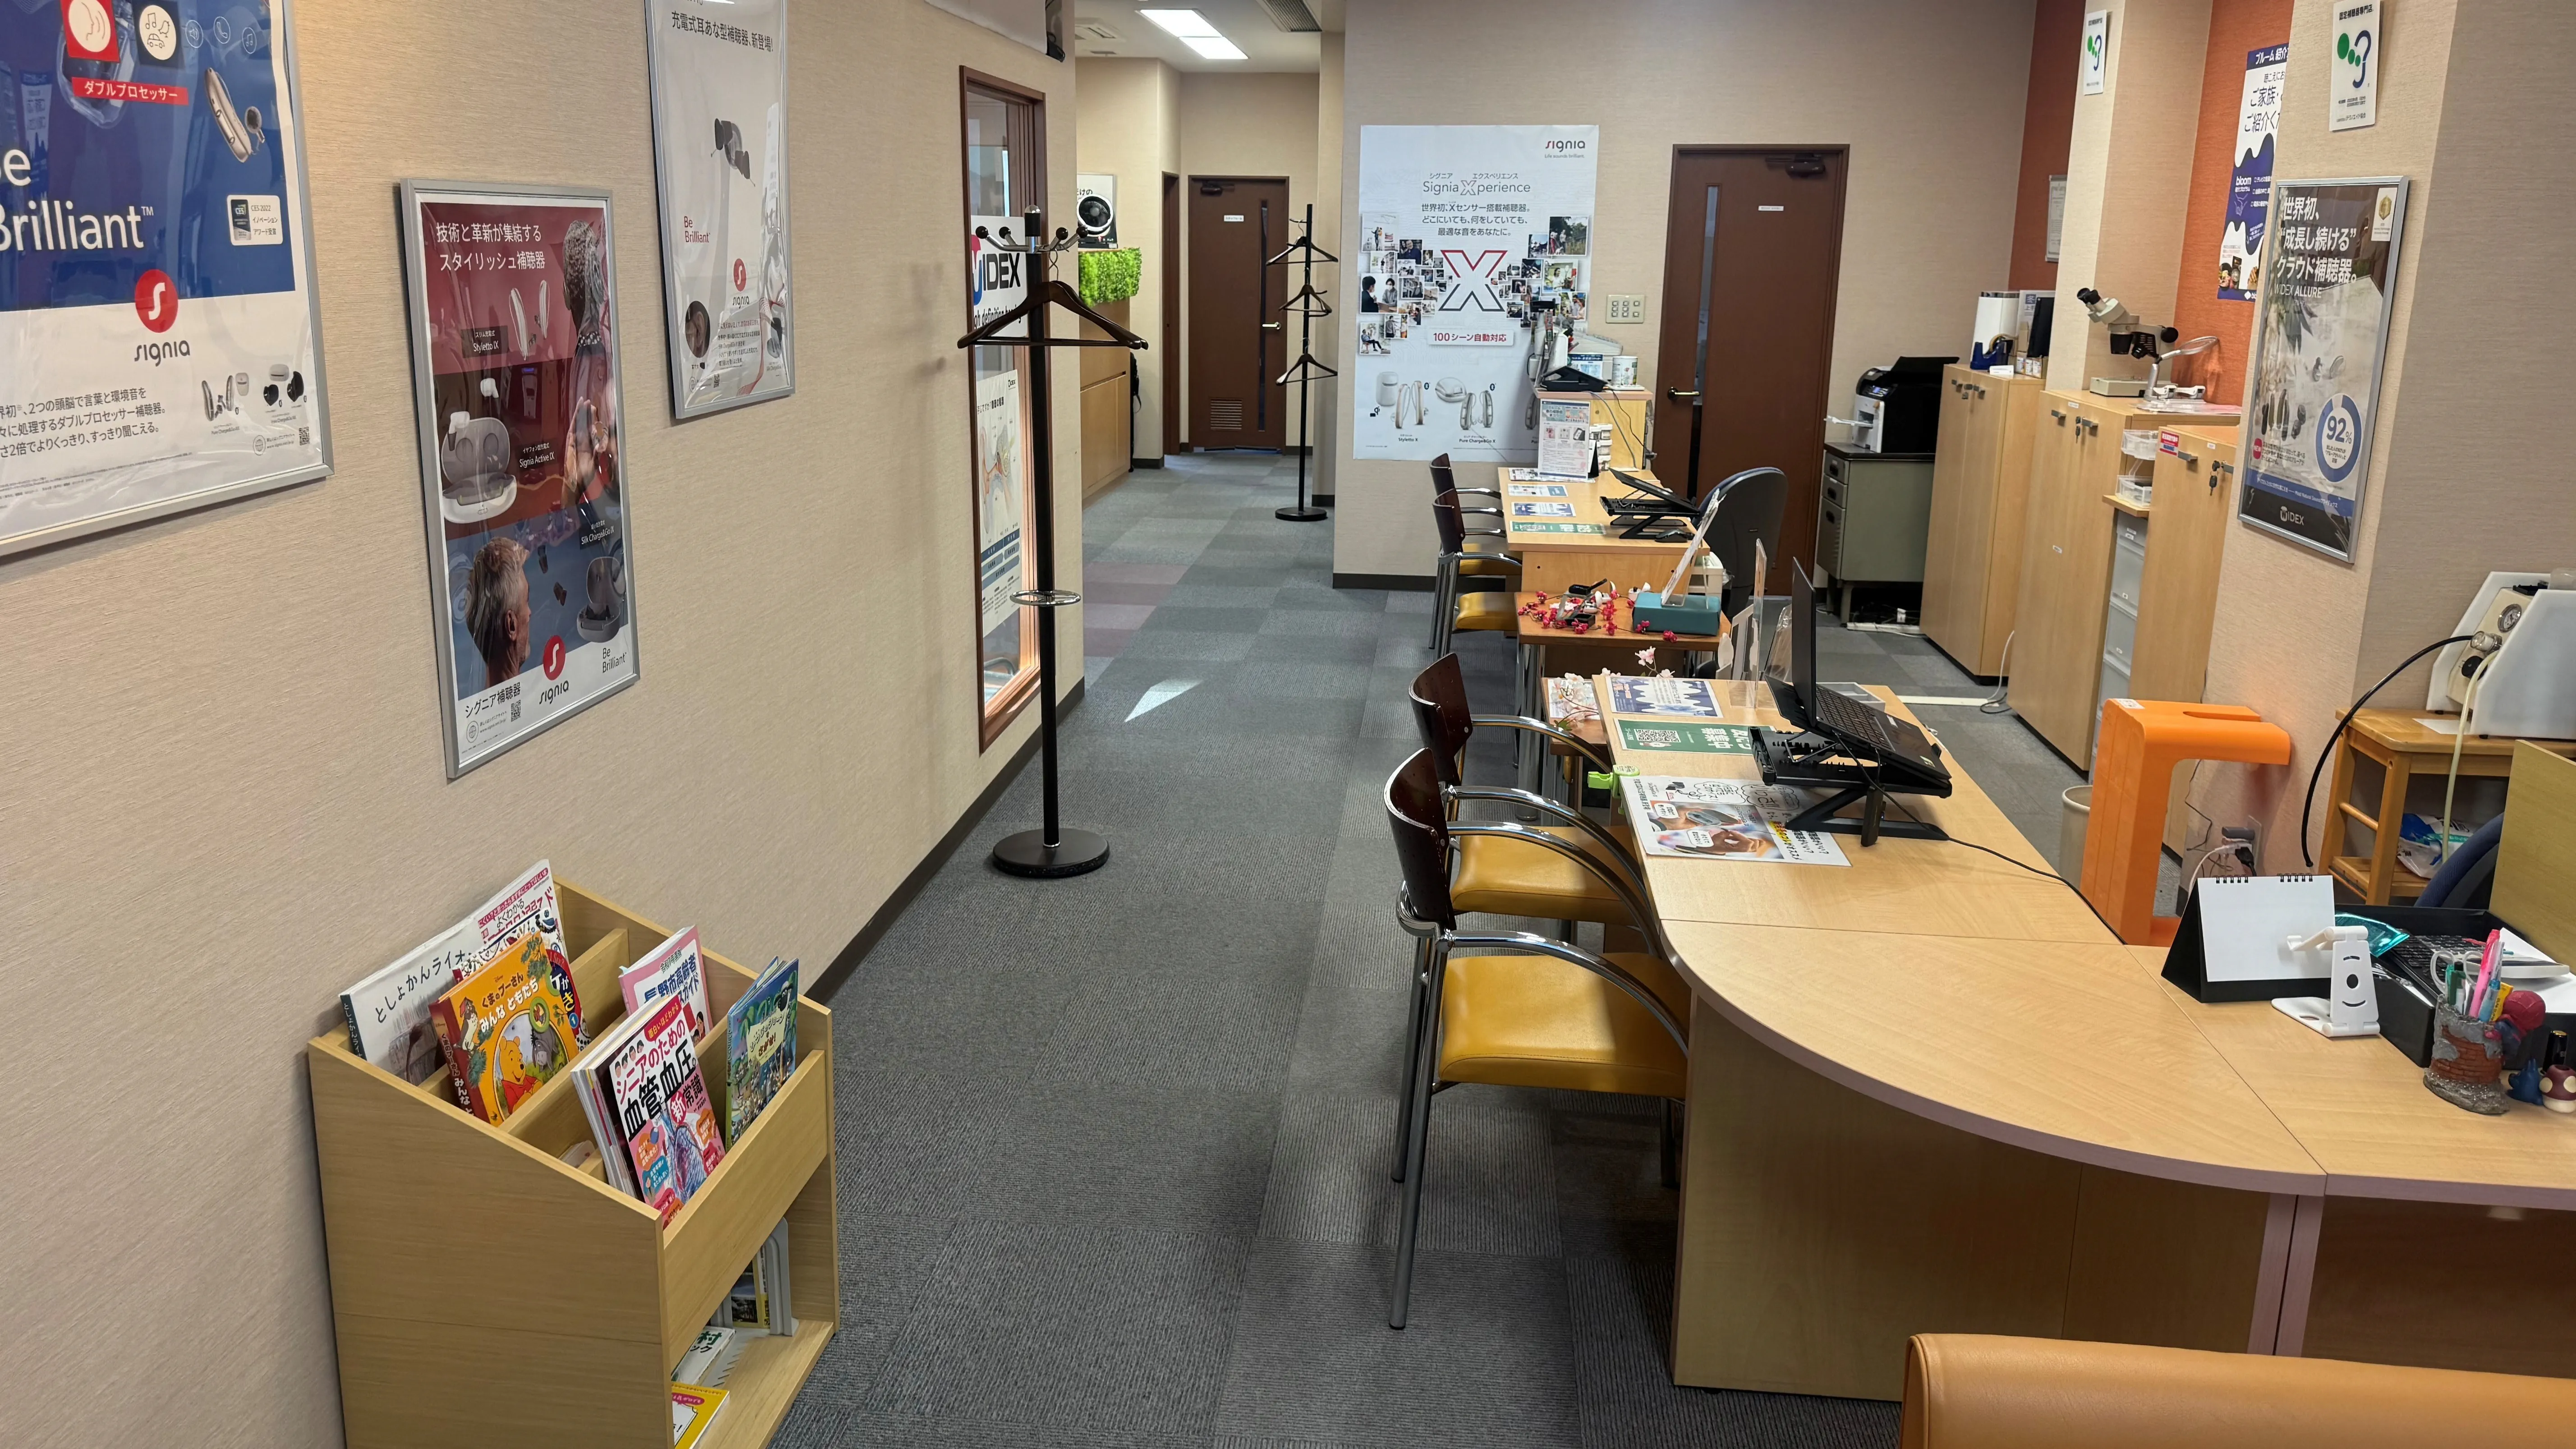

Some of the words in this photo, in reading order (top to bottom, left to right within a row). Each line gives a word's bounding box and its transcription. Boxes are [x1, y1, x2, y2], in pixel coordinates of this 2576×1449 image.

[2256, 50, 2275, 65] ブルーム
[2275, 47, 2289, 60] 紹介
[84, 80, 179, 100] ダブルプロセッサー
[2250, 85, 2282, 107] ご家族・
[2245, 110, 2281, 133] ご紹介く
[1545, 140, 1586, 152] signia
[0, 148, 32, 186] e
[1423, 181, 1459, 195] Signia
[2236, 176, 2252, 185] bloom
[2283, 196, 2319, 221] 世界初、
[684, 216, 693, 228] Be
[1422, 215, 1528, 225] どこにいても、何をしていても、
[436, 222, 542, 243] 技術と革新が集結する
[1438, 228, 1513, 236] 最適な音をあなたに。
[440, 251, 546, 271] スタイリッシュ補聴器
[2277, 257, 2357, 283] クラウド補聴器。
[2274, 283, 2294, 296] WIDEX
[2294, 284, 2322, 299] ALLURE
[732, 295, 750, 309] signia
[474, 341, 492, 352] Styletto
[1433, 332, 1507, 343] 100シーン自動対応
[134, 339, 191, 367] signia
[535, 454, 549, 464] Active
[2280, 506, 2305, 526] WIDEX
[603, 647, 611, 659] Be
[465, 682, 521, 718] シグニア補聴器
[539, 680, 569, 705] signia
[1701, 727, 1734, 749] 募集中
[497, 898, 524, 928] よくわかる
[375, 949, 473, 1024] としょかんライオ
[482, 972, 524, 1008] くまのプーさん
[480, 1005, 506, 1032] みんな
[507, 977, 539, 1011] ともだち
[571, 1017, 576, 1025] 1
[648, 1003, 679, 1039] 面白いほどわかる
[616, 1019, 685, 1104] シニアのための
[454, 1077, 470, 1105] みんな
[697, 1331, 722, 1345] 村
